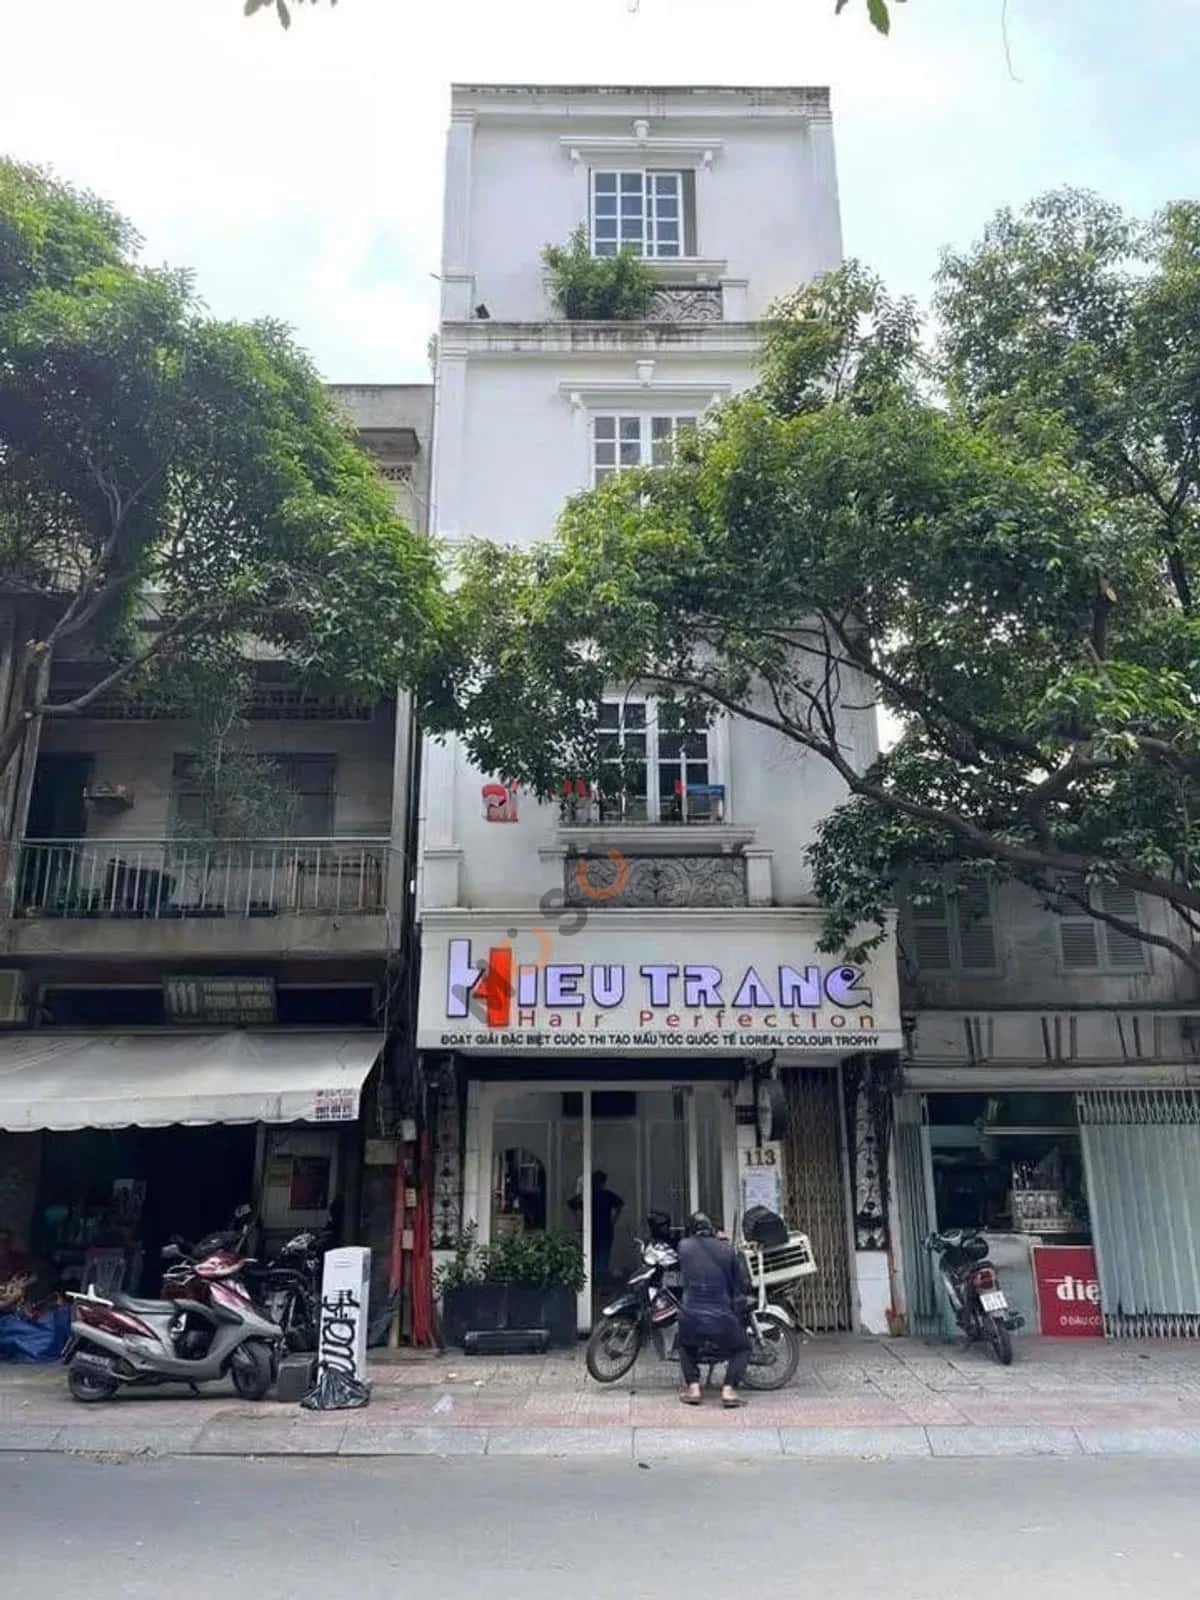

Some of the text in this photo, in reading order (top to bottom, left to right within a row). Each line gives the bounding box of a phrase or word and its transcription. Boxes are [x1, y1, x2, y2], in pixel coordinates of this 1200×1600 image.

[639, 963, 873, 1009] TRANG
[518, 1010, 875, 1028] Hair Perfection
[588, 1034, 607, 1045] THI
[786, 1034, 833, 1046] COLOUR
[835, 1034, 880, 1046] TROPHY
[744, 1148, 777, 1166] 113
